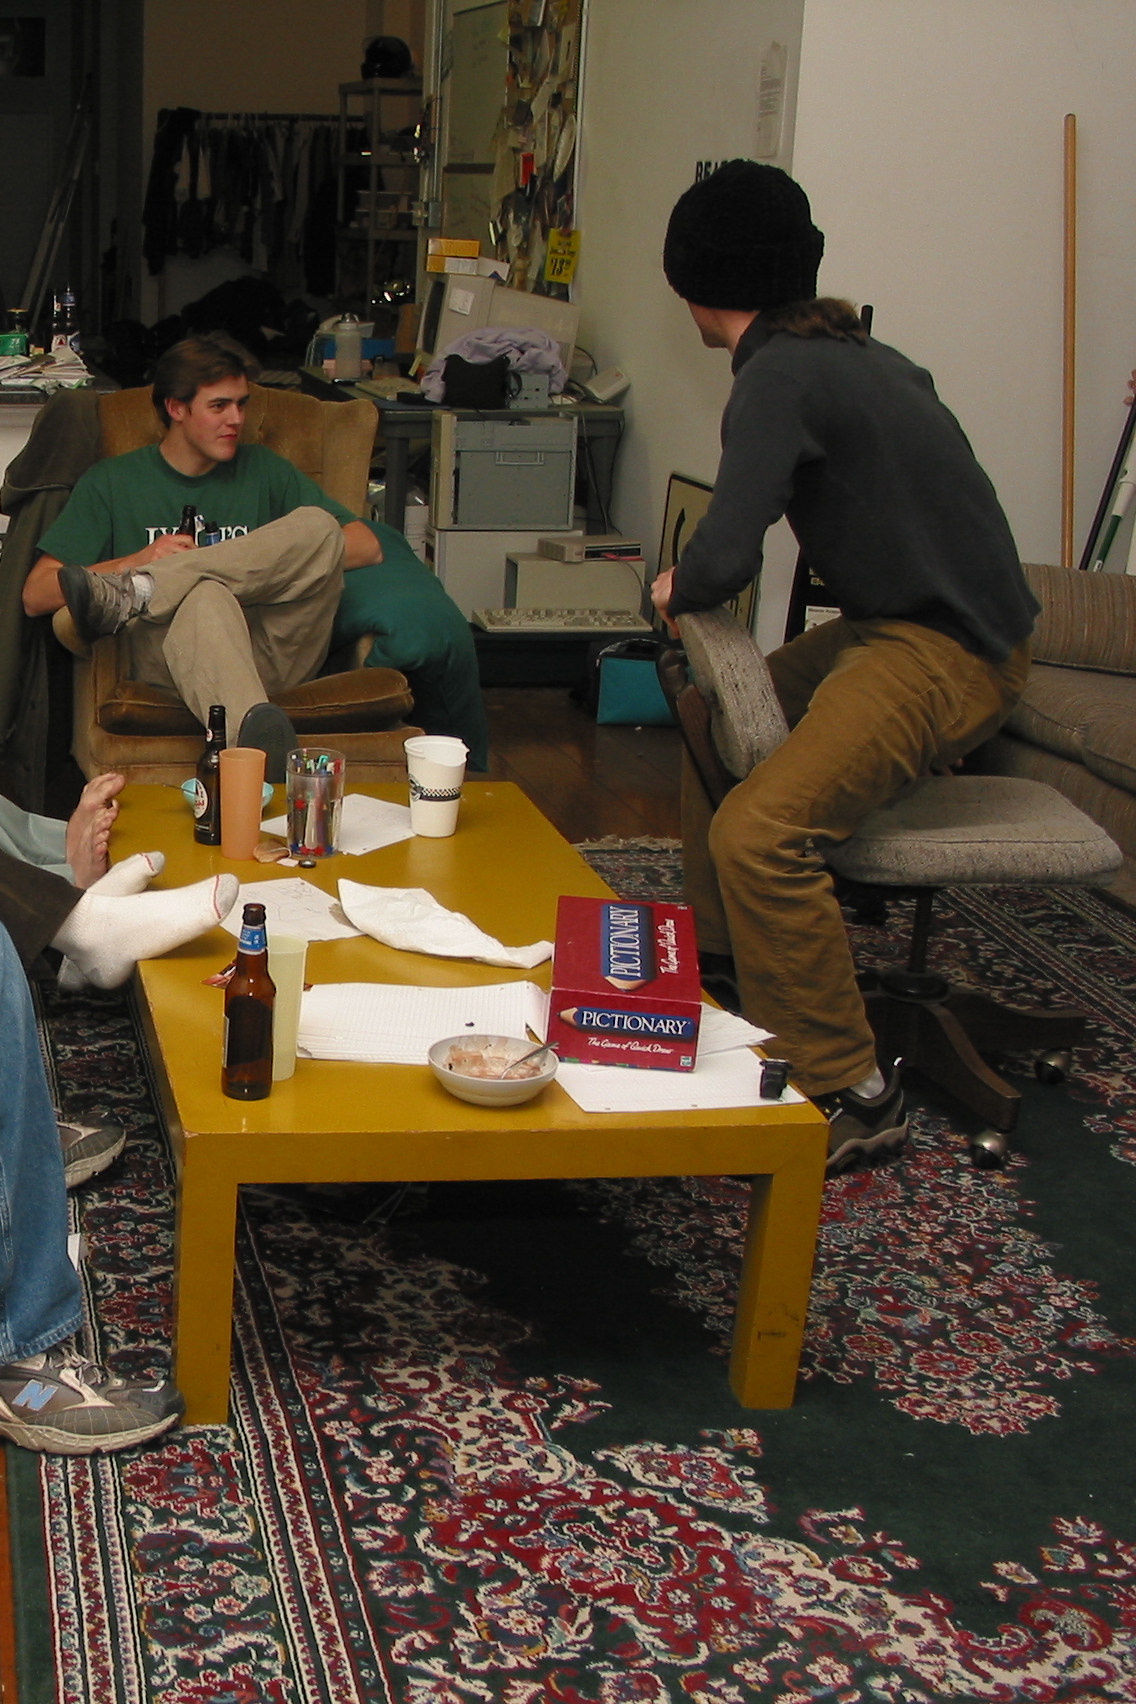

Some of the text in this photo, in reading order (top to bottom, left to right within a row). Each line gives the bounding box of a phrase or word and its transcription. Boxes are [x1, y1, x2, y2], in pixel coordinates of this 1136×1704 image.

[609, 905, 641, 977] PICTIONARY
[582, 1010, 686, 1035] PICTIONARY
[587, 1036, 600, 1046] The
[601, 1039, 621, 1049] Game
[630, 1041, 653, 1053] Quick
[652, 1043, 674, 1054] Draw
